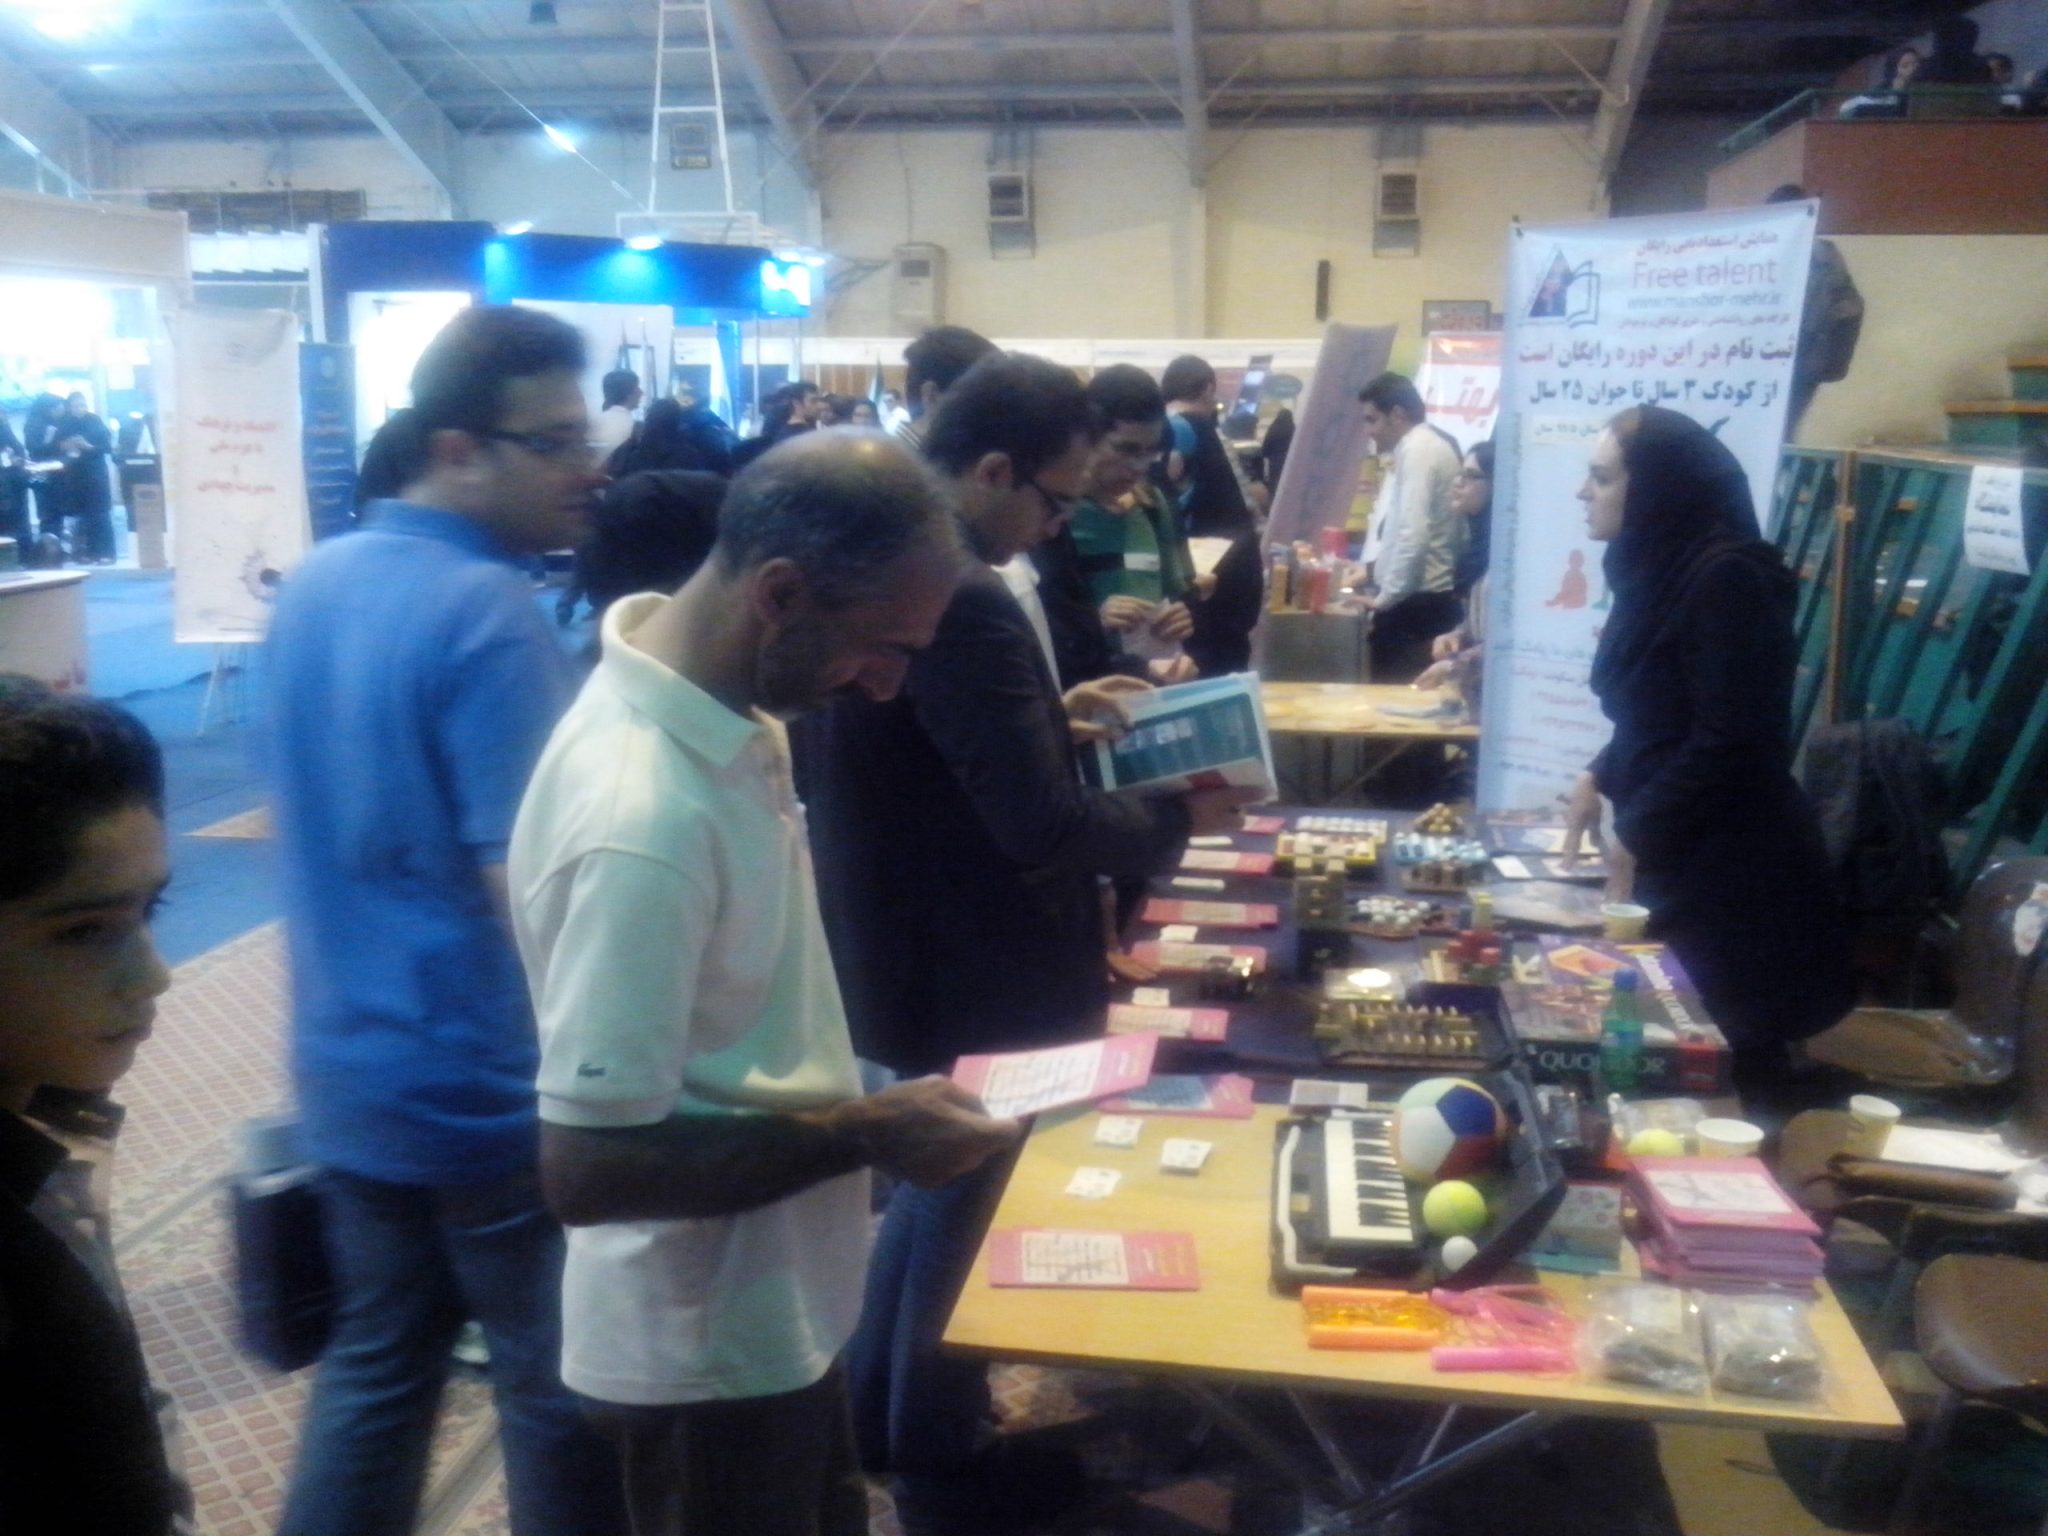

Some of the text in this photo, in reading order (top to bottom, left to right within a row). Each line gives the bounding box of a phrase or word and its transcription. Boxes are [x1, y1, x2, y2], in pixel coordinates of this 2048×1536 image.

[1632, 256, 1778, 289] Free talent
[1518, 334, 1795, 369] ثبت نام در این دوره رایگان است
[1529, 380, 1557, 405] سال
[1587, 380, 1628, 406] جوان
[1631, 379, 1644, 400] تا
[1646, 380, 1680, 407] سال
[1702, 380, 1757, 408] کودک
[1760, 379, 1778, 408] از
